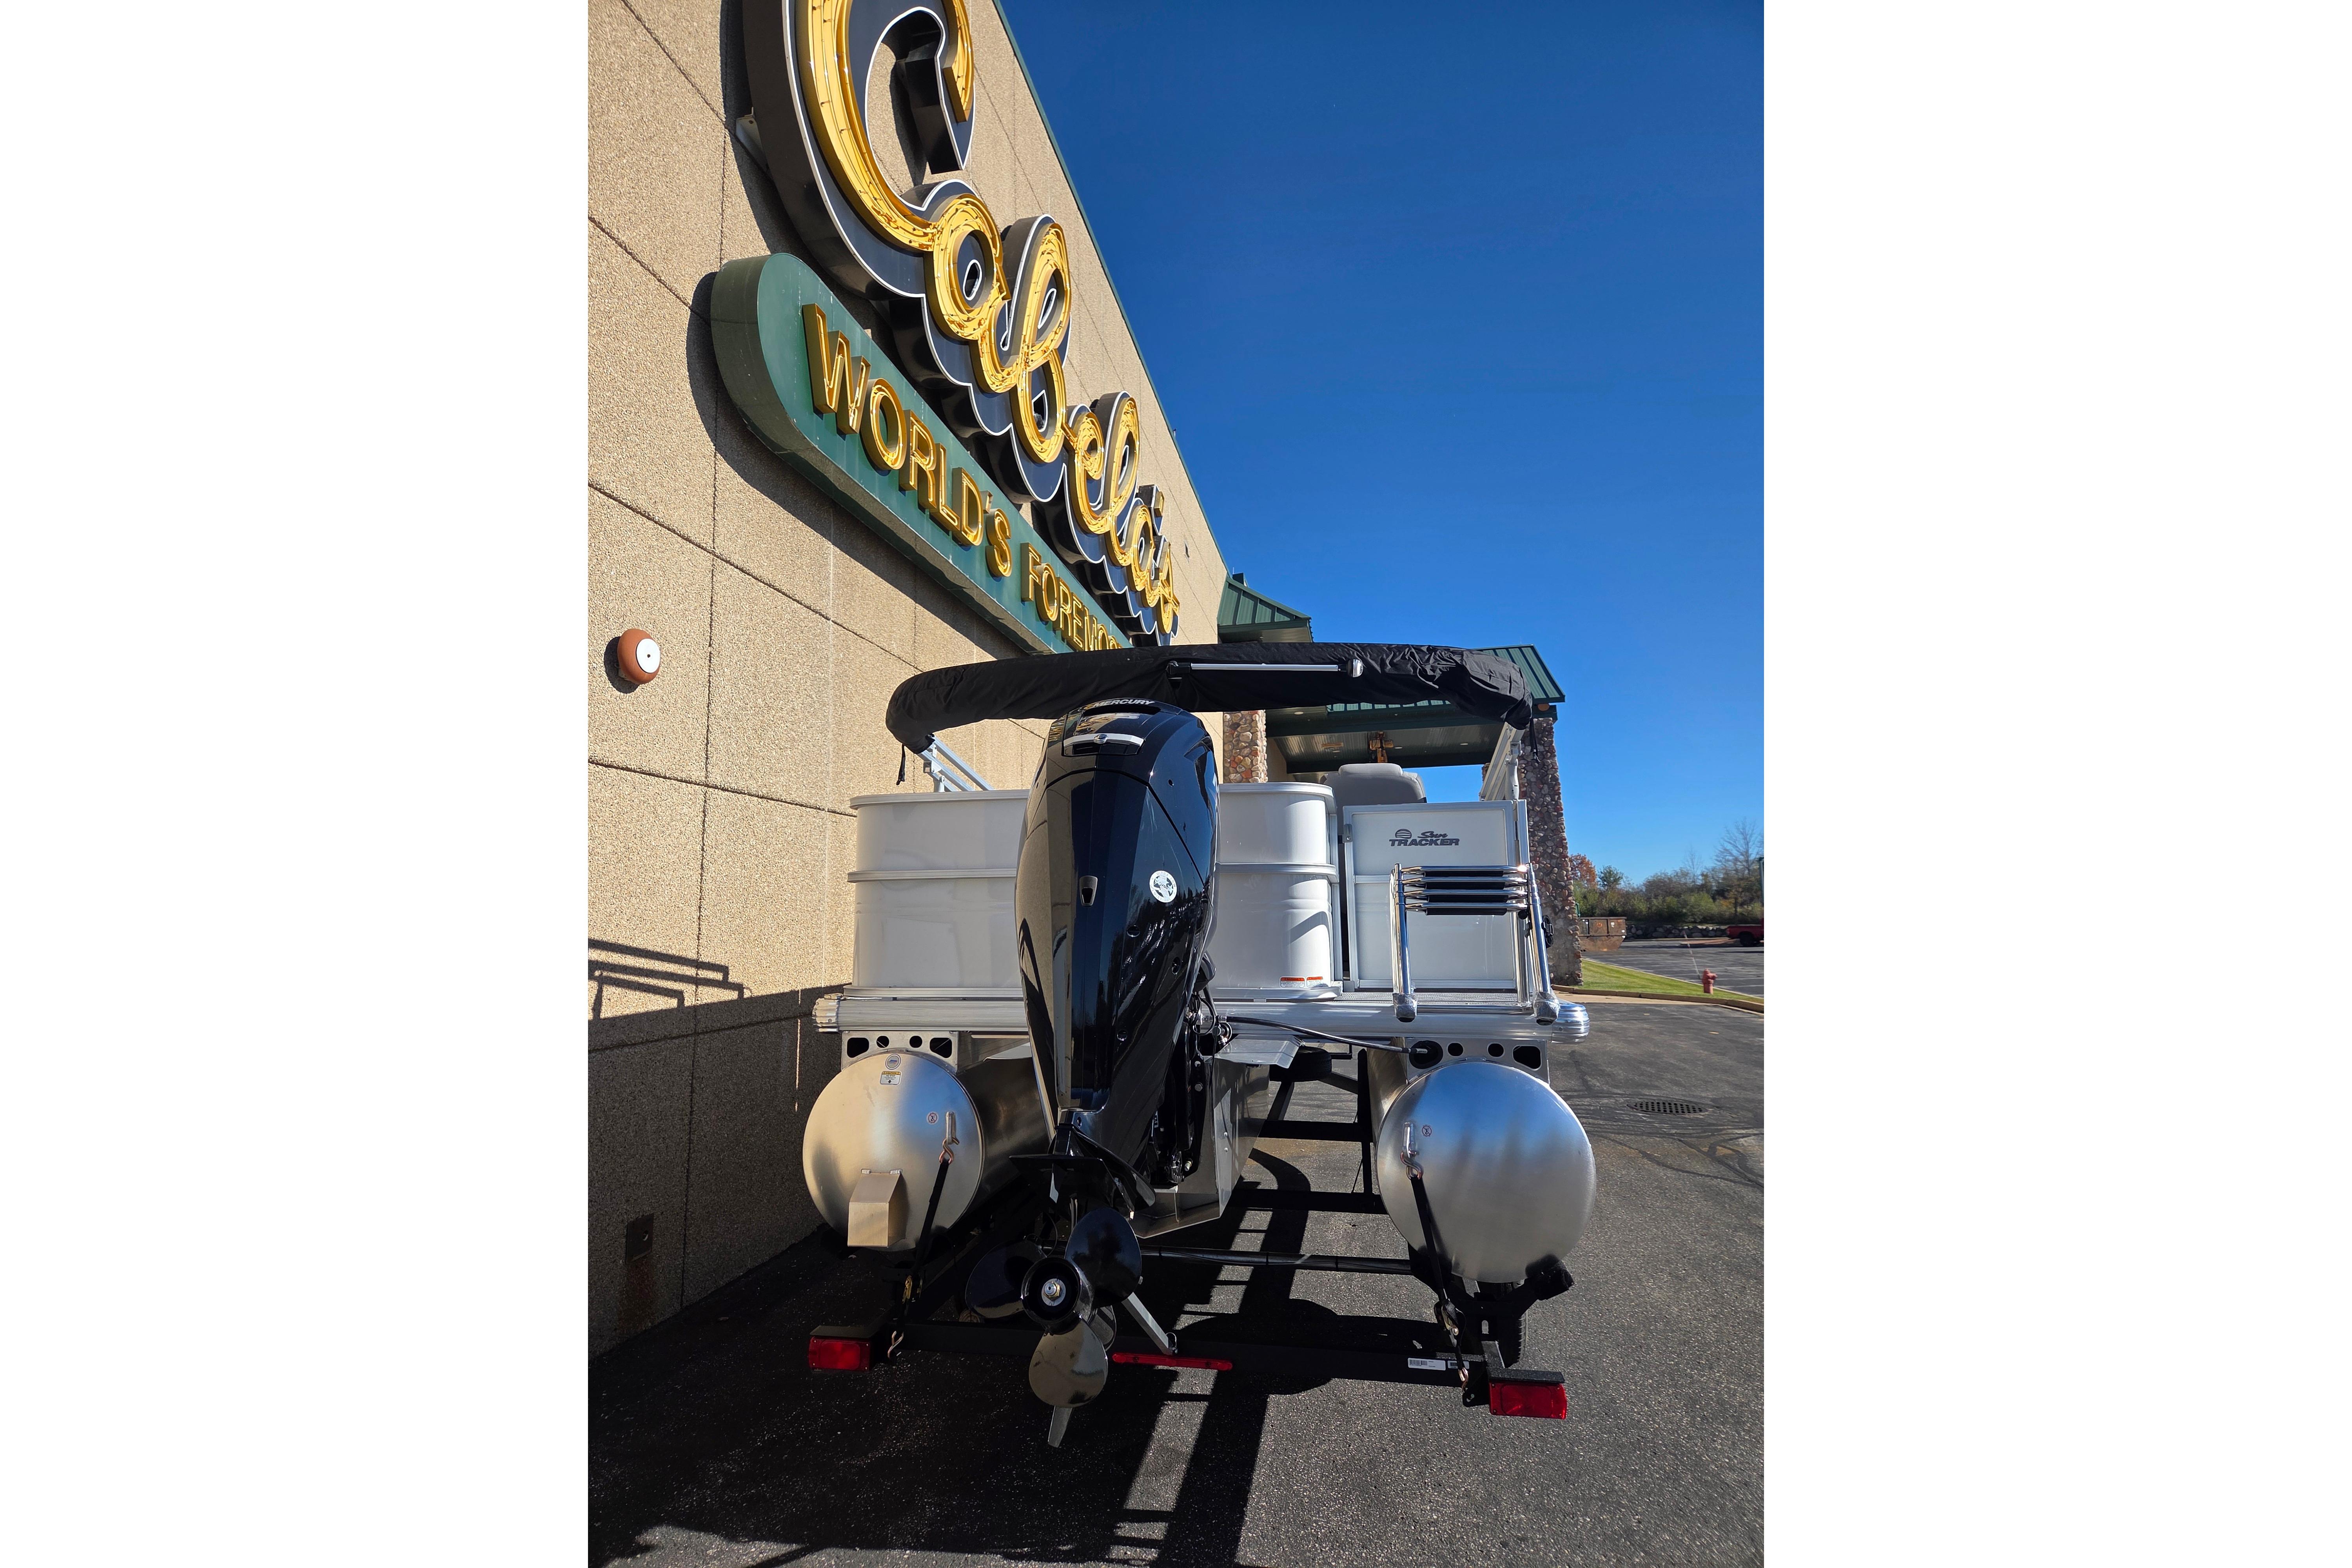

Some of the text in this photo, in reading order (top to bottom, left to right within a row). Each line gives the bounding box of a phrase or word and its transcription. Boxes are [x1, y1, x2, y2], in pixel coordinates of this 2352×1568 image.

[803, 304, 1122, 652] WORLD'S FOREMO
[1093, 699, 1155, 707] MERCURY
